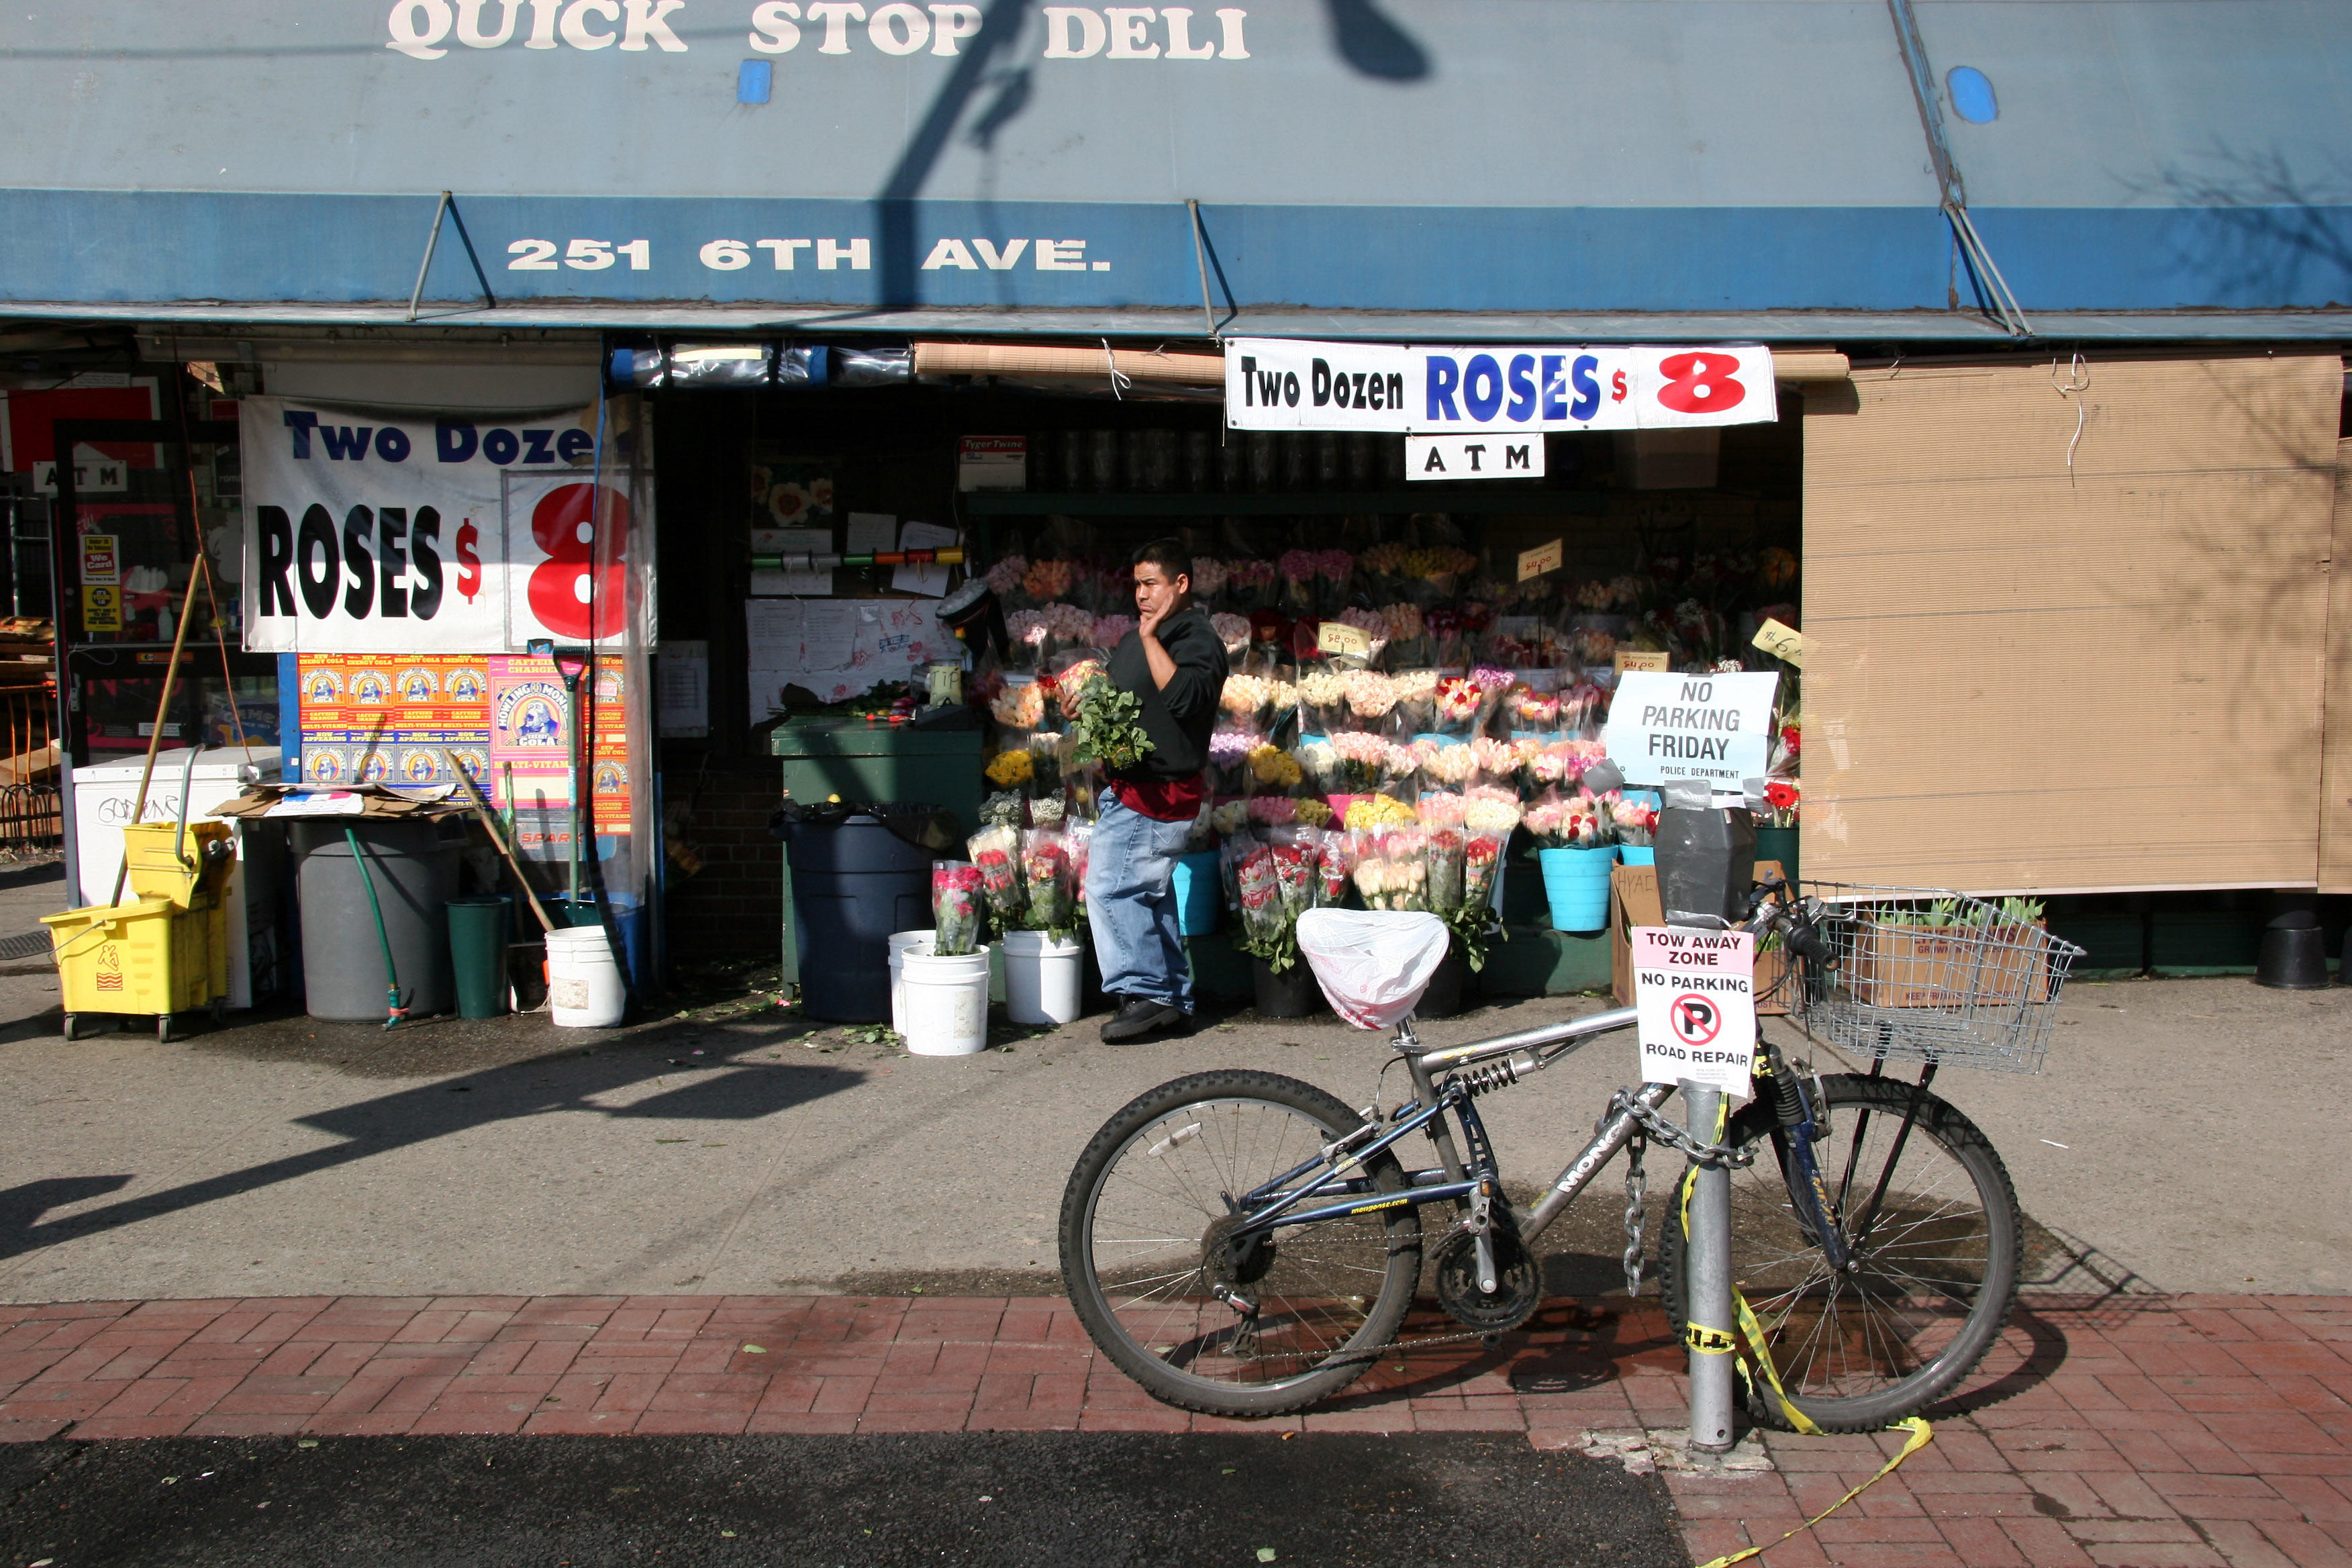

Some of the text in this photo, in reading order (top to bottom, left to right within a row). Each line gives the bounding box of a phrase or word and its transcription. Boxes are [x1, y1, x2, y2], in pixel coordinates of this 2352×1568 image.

[385, 0, 1251, 60] QUICK STOP DELI
[508, 239, 1111, 271] 251 6TH AVE.
[1241, 356, 1300, 407] Two
[1312, 358, 1403, 410] Dozen
[1426, 354, 1600, 422] ROSES
[284, 410, 594, 465] Two Doze
[966, 440, 1023, 449] Tyger Twine
[258, 503, 444, 620] ROSES
[1680, 682, 1712, 703] NO
[498, 685, 531, 727] HOWLING
[1642, 705, 1741, 732] PARKING
[518, 738, 557, 746] COLA
[1649, 734, 1729, 761] FRIDAY
[1660, 766, 1739, 779] POLICE DEPARTMENT
[1647, 933, 1741, 950] TOW AWAY
[1669, 951, 1718, 965] ZONE
[1642, 973, 1748, 993] NO PARKING
[1647, 1044, 1748, 1067] ROAD REPAIR
[1351, 1199, 1409, 1214] mongoose.com
